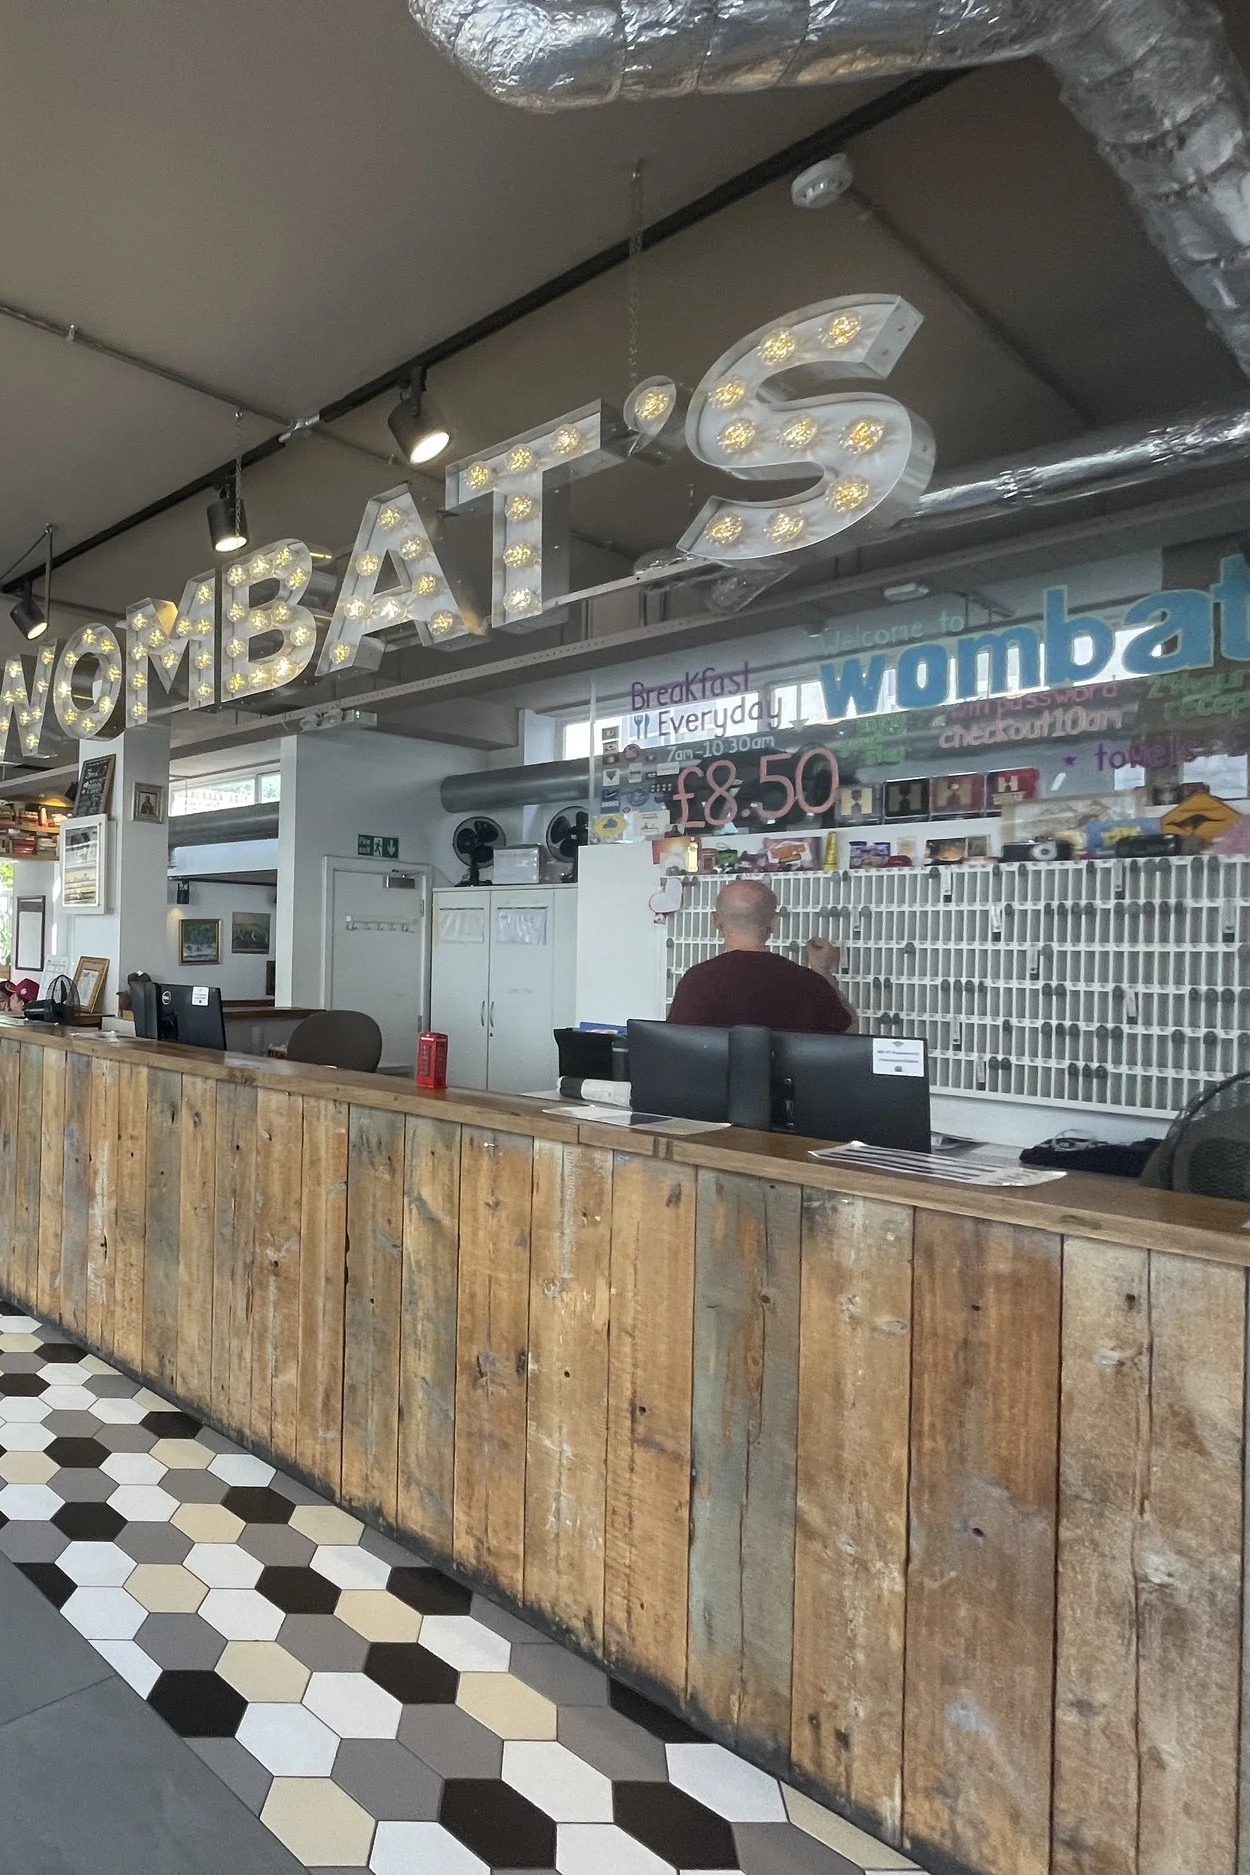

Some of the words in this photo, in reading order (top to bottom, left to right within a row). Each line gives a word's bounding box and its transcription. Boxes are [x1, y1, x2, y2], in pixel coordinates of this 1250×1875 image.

[818, 622, 924, 655] Welcome
[939, 610, 965, 634] to
[658, 695, 782, 738] Everyday
[673, 747, 840, 828] £8.50
